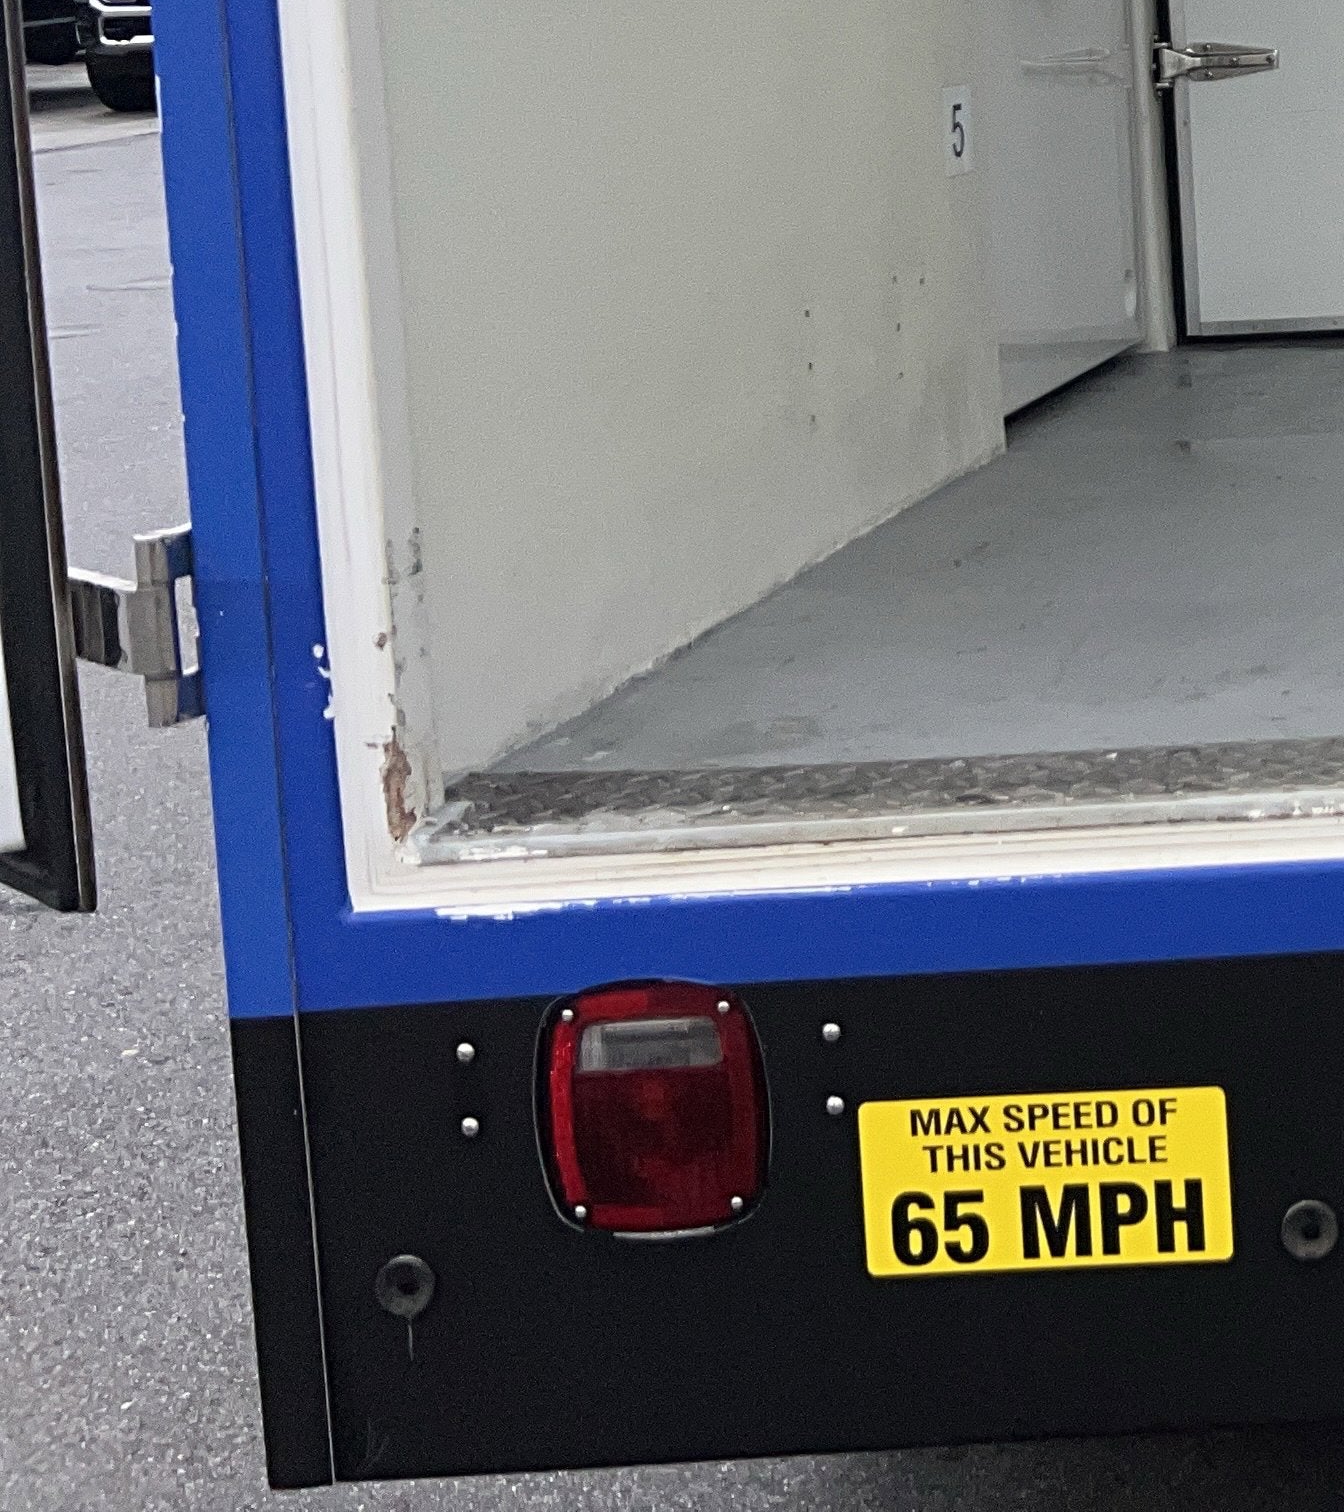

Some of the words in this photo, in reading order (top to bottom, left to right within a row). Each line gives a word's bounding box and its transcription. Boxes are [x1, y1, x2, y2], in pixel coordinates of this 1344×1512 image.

[951, 102, 966, 159] 5
[909, 1105, 992, 1137] MAX
[1002, 1101, 1119, 1134] SPEED
[1131, 1097, 1179, 1128] OF
[922, 1141, 1007, 1174] THIS
[1018, 1135, 1169, 1169] VEHICLE
[890, 1189, 990, 1267] 65
[1018, 1178, 1207, 1260] MPH
